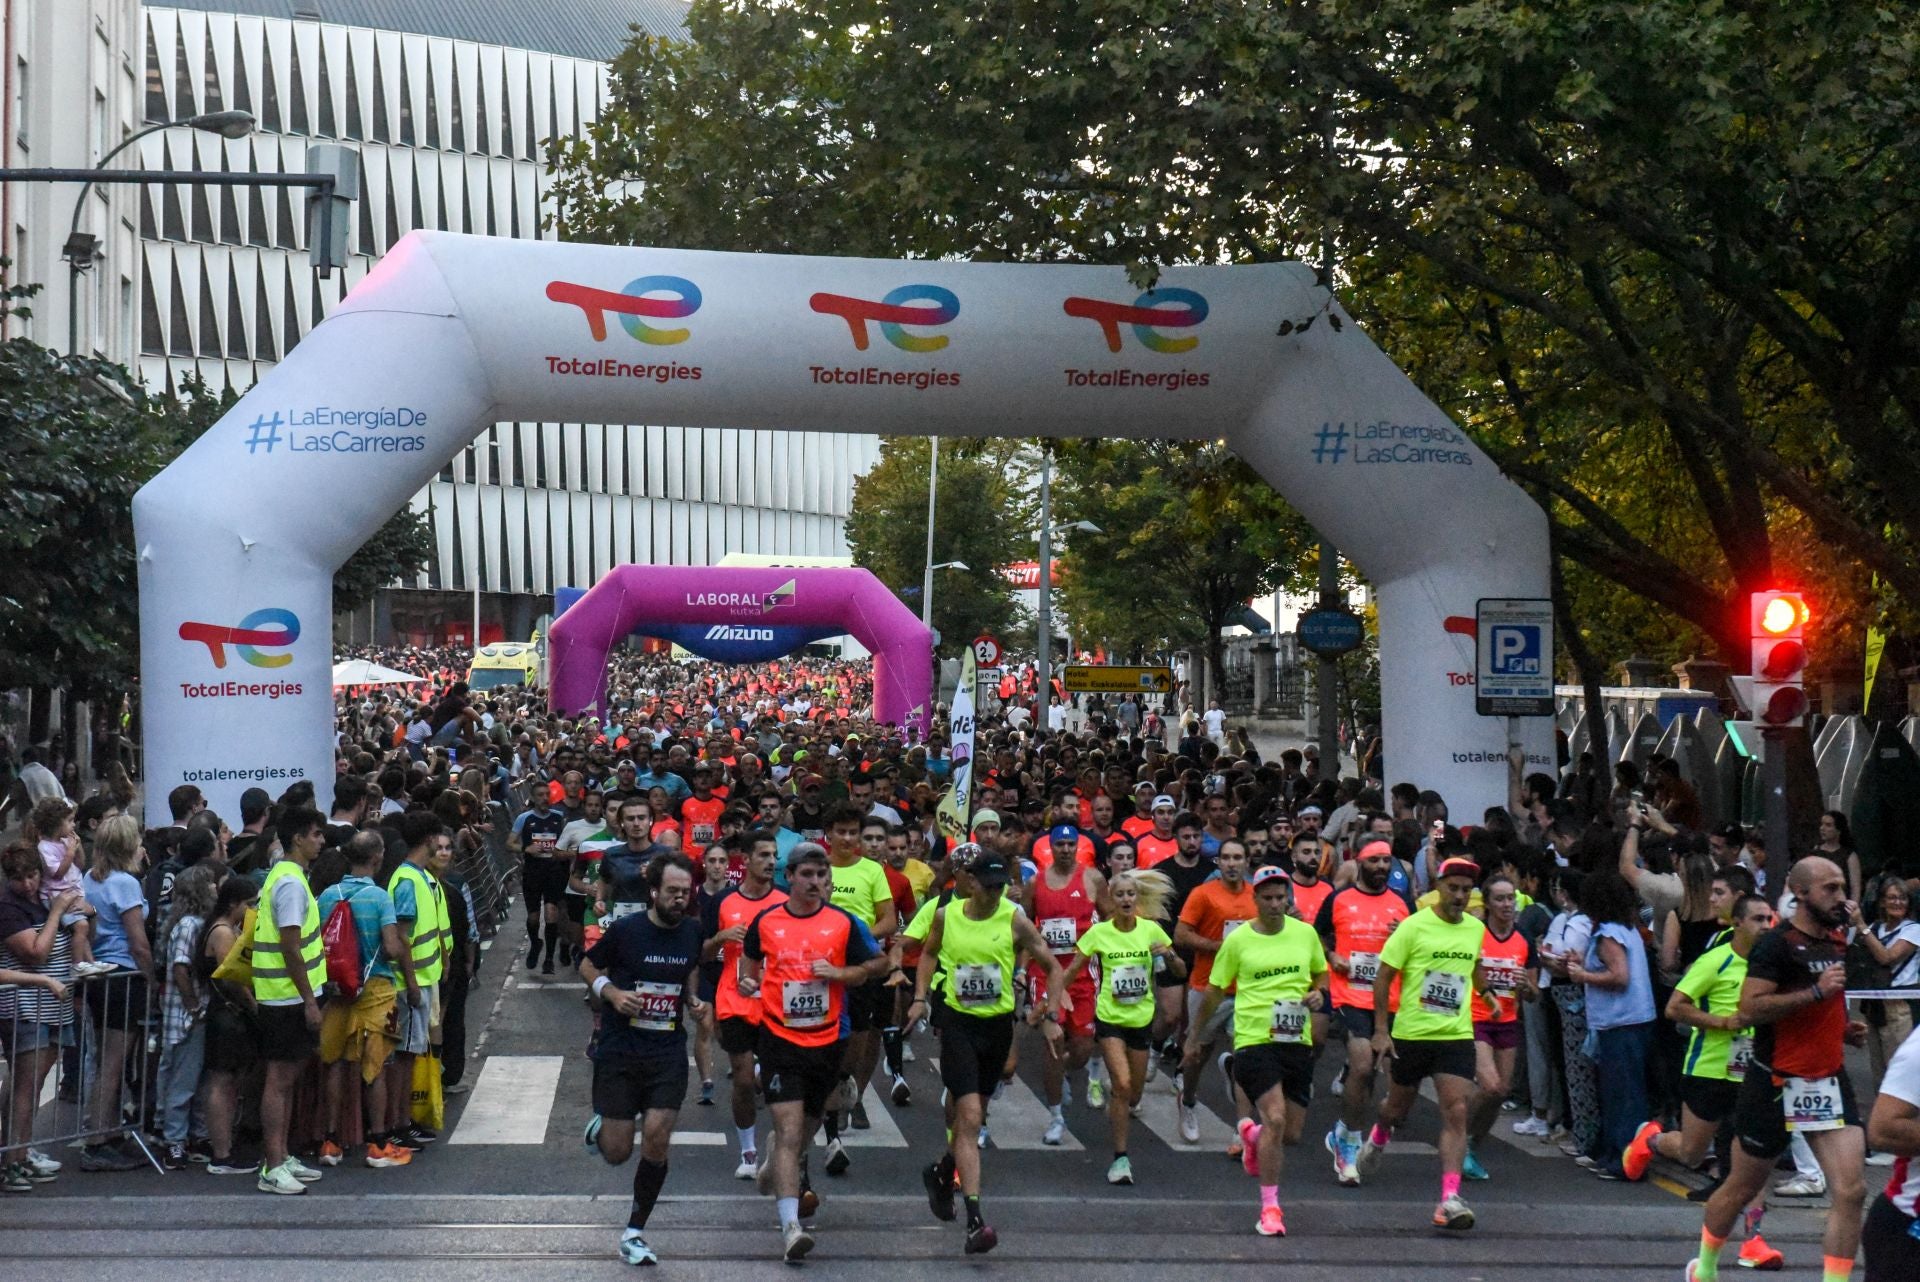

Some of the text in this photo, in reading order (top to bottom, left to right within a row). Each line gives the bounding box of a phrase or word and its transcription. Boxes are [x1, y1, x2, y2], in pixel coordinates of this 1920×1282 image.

[545, 356, 702, 383] TotalEnergies
[809, 366, 961, 390] TotalEnergies
[1064, 369, 1210, 391] TotalEnergies
[290, 431, 426, 452] LasCarreras
[1354, 443, 1472, 466] LasCarreras
[686, 593, 760, 606] LABORAL
[730, 607, 761, 616] kutxa
[1496, 629, 1526, 671] P
[180, 680, 302, 699] TotalEnergies
[183, 766, 304, 782] totalenergies.es
[1046, 930, 1071, 941] 5145
[1432, 951, 1473, 960] GOLDCAR
[1254, 965, 1300, 979] GOLDCAR
[1355, 965, 1376, 976] 500
[961, 978, 994, 991] 4516
[1114, 977, 1147, 990] 12106
[1427, 984, 1457, 999] 3968
[790, 995, 823, 1009] 4995
[1793, 1095, 1833, 1109] 4092
